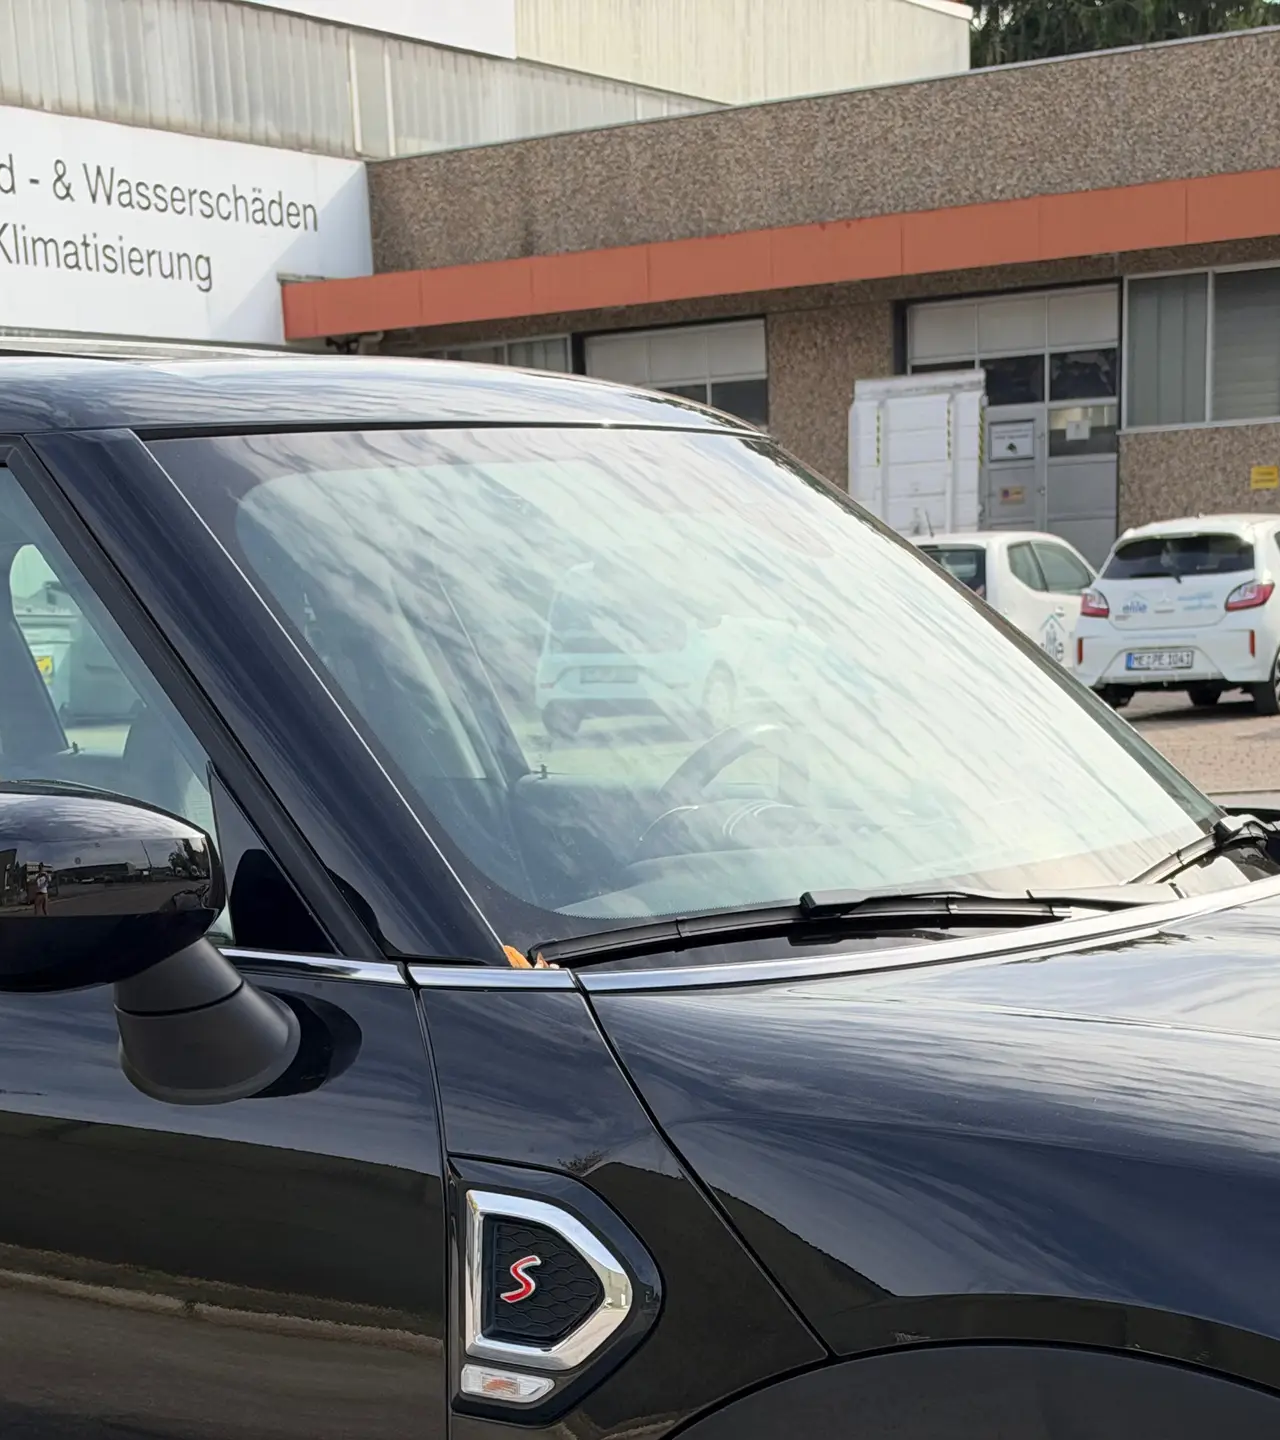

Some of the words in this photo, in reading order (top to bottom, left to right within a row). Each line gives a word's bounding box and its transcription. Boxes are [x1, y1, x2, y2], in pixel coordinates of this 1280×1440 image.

[53, 159, 75, 201] &
[82, 162, 319, 232] Wasserschäden
[500, 1254, 542, 1304] S
